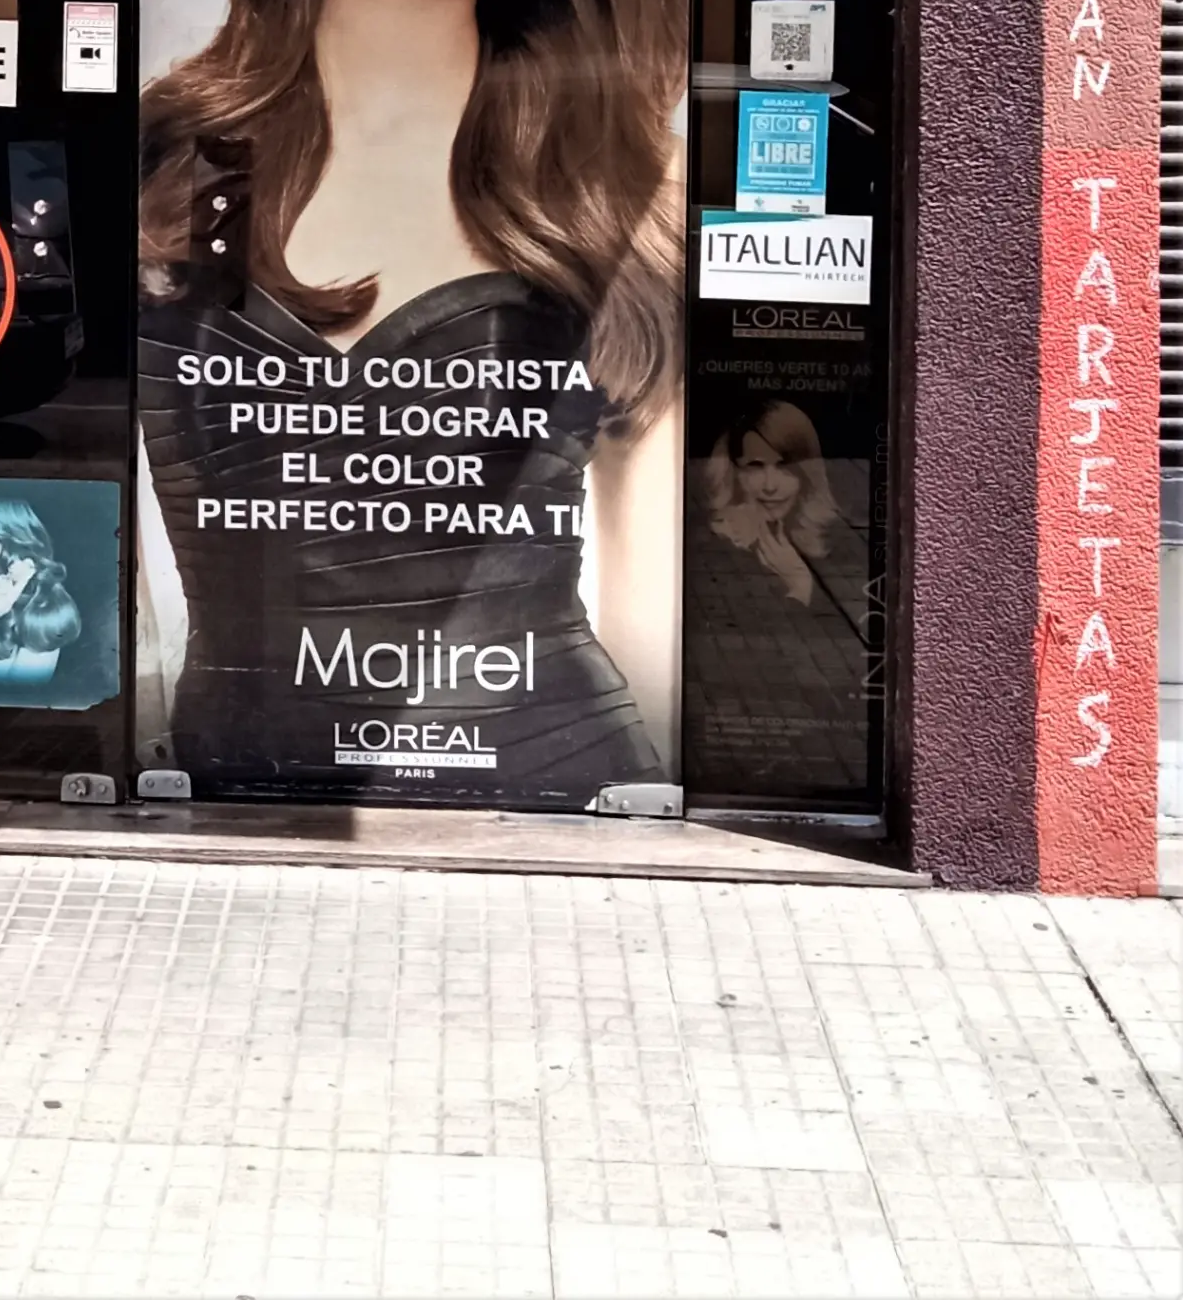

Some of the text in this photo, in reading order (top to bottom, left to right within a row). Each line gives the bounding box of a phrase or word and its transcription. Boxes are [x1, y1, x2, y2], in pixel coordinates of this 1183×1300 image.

[751, 141, 813, 166] LIBRE
[707, 233, 866, 268] ITALLIAN
[805, 273, 866, 282] HAIRTECH
[177, 355, 593, 392] SOLO TU COLORISTA
[230, 403, 549, 438] PUEDE LOGRAR
[282, 452, 485, 486] EL COLOR
[1069, 177, 1120, 768] TARJETAS
[197, 499, 581, 536] PERFECTO PARA TI
[294, 627, 534, 704] Majirel
[334, 720, 497, 752] L'ORÉAL
[395, 768, 436, 779] PARIS
